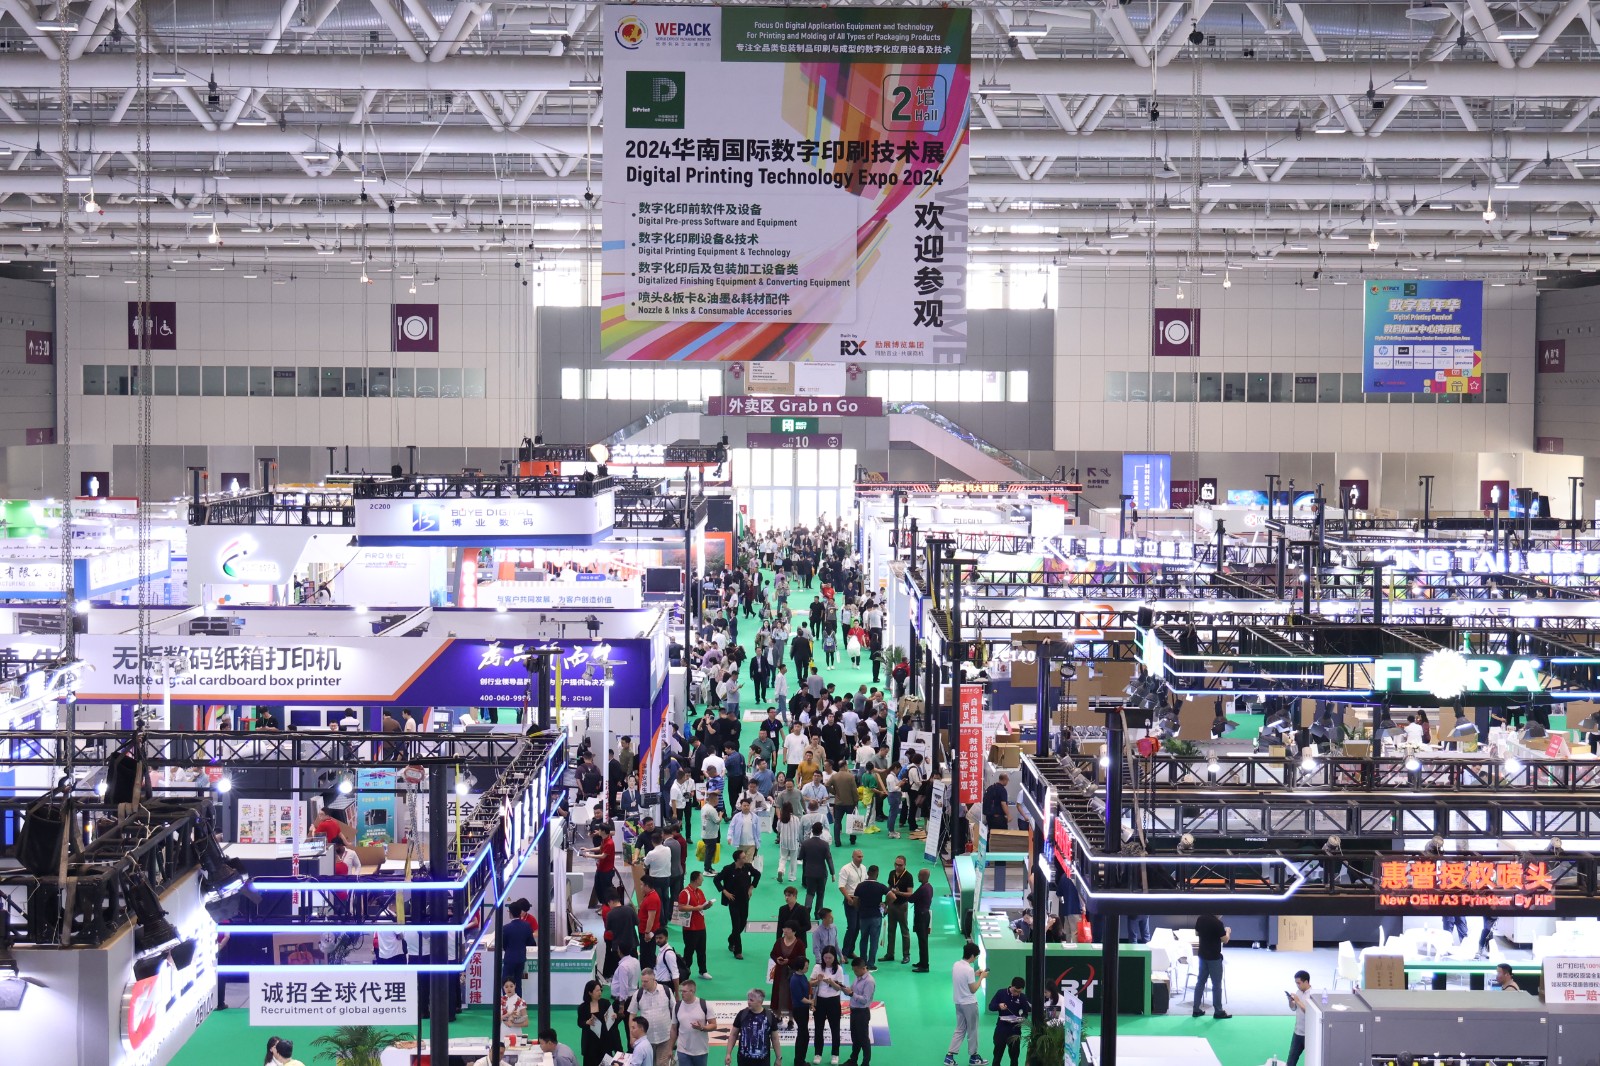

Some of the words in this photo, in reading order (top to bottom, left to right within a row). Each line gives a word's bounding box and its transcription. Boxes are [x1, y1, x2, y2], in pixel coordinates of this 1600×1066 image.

[656, 22, 712, 36] WEPACK
[786, 22, 806, 30] Digital
[808, 22, 844, 30] Application
[847, 23, 881, 31] Equipment
[897, 24, 934, 32] Technology
[759, 32, 786, 40] Printing
[801, 32, 826, 41] Molding
[847, 33, 865, 41] Types
[876, 34, 909, 42] Packaging
[915, 86, 934, 106] 馆
[891, 86, 912, 120] 2
[915, 110, 938, 121] Hall
[626, 138, 944, 163] 2024华南国际数字印刷技术展
[626, 166, 680, 186] Digital
[686, 166, 753, 188] Printing
[758, 168, 853, 188] Technology
[858, 170, 898, 188] Expo
[903, 170, 944, 186] 2024
[638, 202, 762, 216] 数字化印前软件及设备
[638, 217, 664, 226] Digital
[666, 217, 702, 226] Pre-press
[704, 218, 739, 226] Software
[741, 218, 755, 226] and
[757, 218, 797, 228] Equipment
[638, 232, 759, 245] 数字化印刷设备&技术
[638, 247, 664, 256] Digital
[665, 247, 696, 256] Printing
[698, 248, 738, 257] Equipment
[740, 248, 746, 256] &
[748, 248, 790, 258] Technology
[638, 262, 798, 275] 数字化印后及包装加工设备类
[913, 202, 944, 328] 欢迎参观
[638, 276, 678, 286] Digitalized
[680, 277, 714, 286] Finishing
[716, 277, 756, 287] Equipment
[766, 278, 808, 288] Converting
[810, 278, 850, 288] Equipment
[638, 292, 790, 305] 喷头&板卡&油墨&耗材配件
[638, 306, 662, 314] Nozzle
[698, 307, 744, 316] Consumable
[746, 308, 792, 316] Accessories
[840, 340, 866, 356] RX
[728, 398, 774, 414] 外卖区
[780, 400, 818, 412] Grab
[822, 402, 831, 412] n
[836, 400, 858, 412] Go
[795, 436, 809, 448] 10
[452, 518, 534, 527] 博业数码
[199, 674, 266, 686] cardboard
[269, 674, 293, 686] box
[296, 674, 342, 688] printer
[1380, 861, 1553, 890] 惠普授权喷头
[1380, 895, 1407, 906] New
[1410, 895, 1439, 906] OEM
[1442, 895, 1458, 906] A3
[1462, 895, 1512, 906] Printbar
[1515, 895, 1531, 908] By
[1535, 895, 1553, 906] HP
[469, 952, 482, 1004] 深圳印捷
[261, 982, 406, 1003] 诚招全球代理
[339, 1006, 370, 1015] global
[372, 1006, 407, 1015] agents
